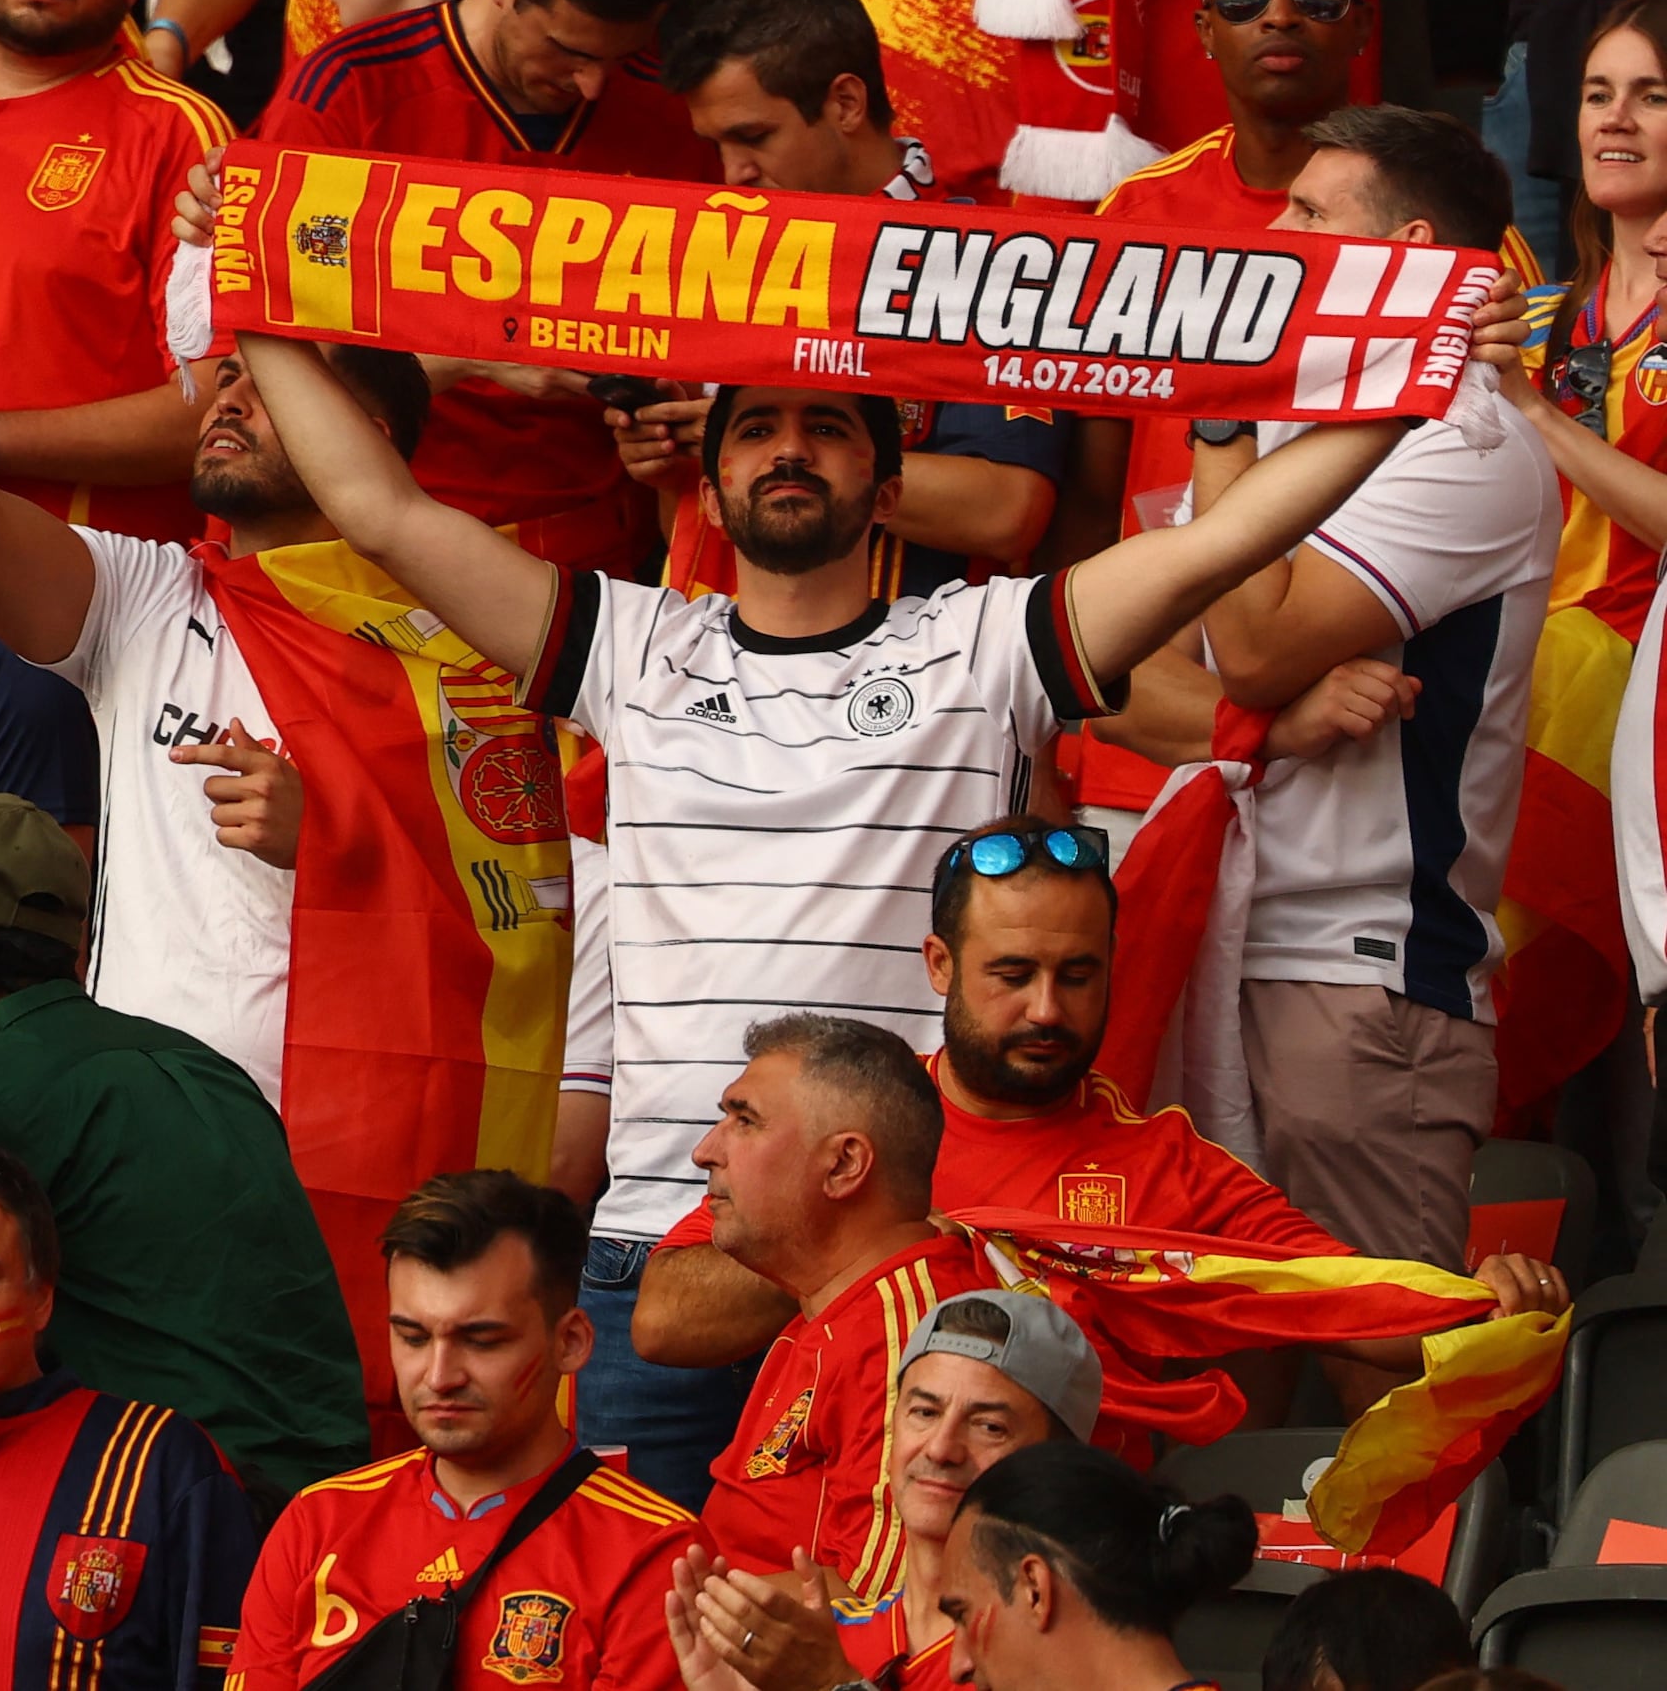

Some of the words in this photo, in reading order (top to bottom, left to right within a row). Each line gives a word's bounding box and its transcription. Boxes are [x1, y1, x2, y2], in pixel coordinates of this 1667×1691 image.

[214, 165, 261, 294] ESPAÑA
[390, 182, 838, 331] ESPAÑA
[854, 221, 1306, 365] ENGLAND
[529, 317, 670, 360] BERLIN
[1416, 265, 1499, 390] ENGLAND
[793, 336, 870, 378] FINAL
[983, 354, 1175, 400] 14.07.2024
[684, 707, 738, 725] adidas
[415, 1567, 465, 1585] adidas
